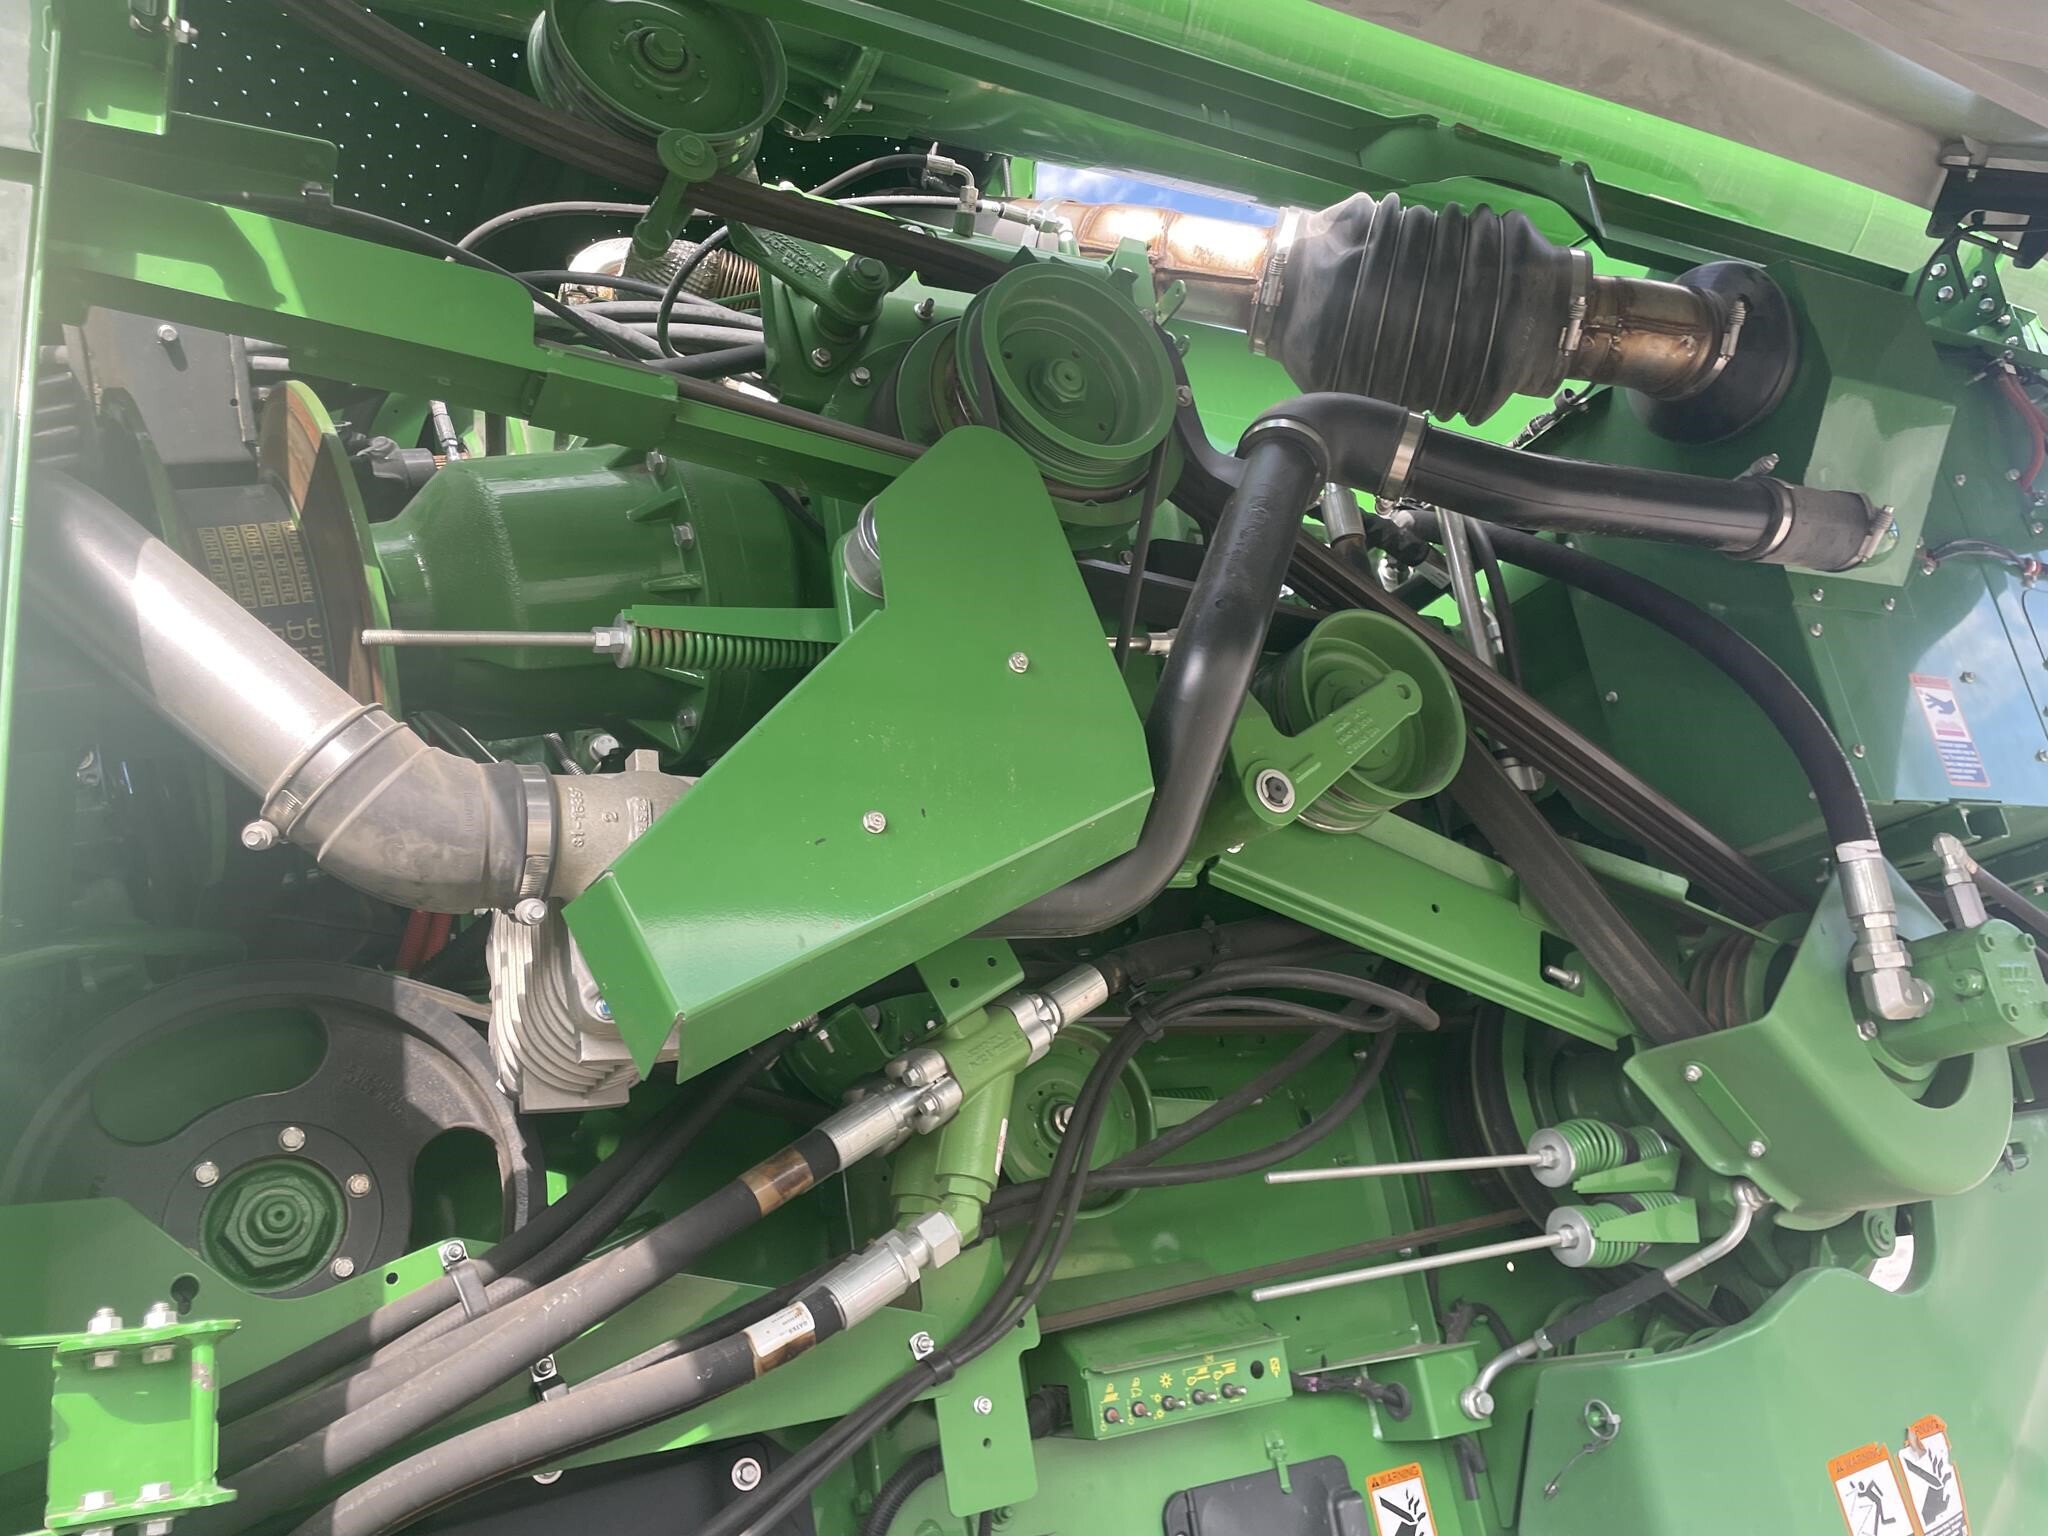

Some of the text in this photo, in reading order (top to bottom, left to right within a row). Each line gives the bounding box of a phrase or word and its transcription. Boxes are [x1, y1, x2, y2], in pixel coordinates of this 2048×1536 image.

[200, 529, 223, 560] JOHN
[221, 526, 242, 559] JOHN
[243, 524, 264, 556] JOHN
[254, 560, 278, 606] DEERE
[263, 523, 285, 555] JOHN
[275, 558, 298, 604] DEERE
